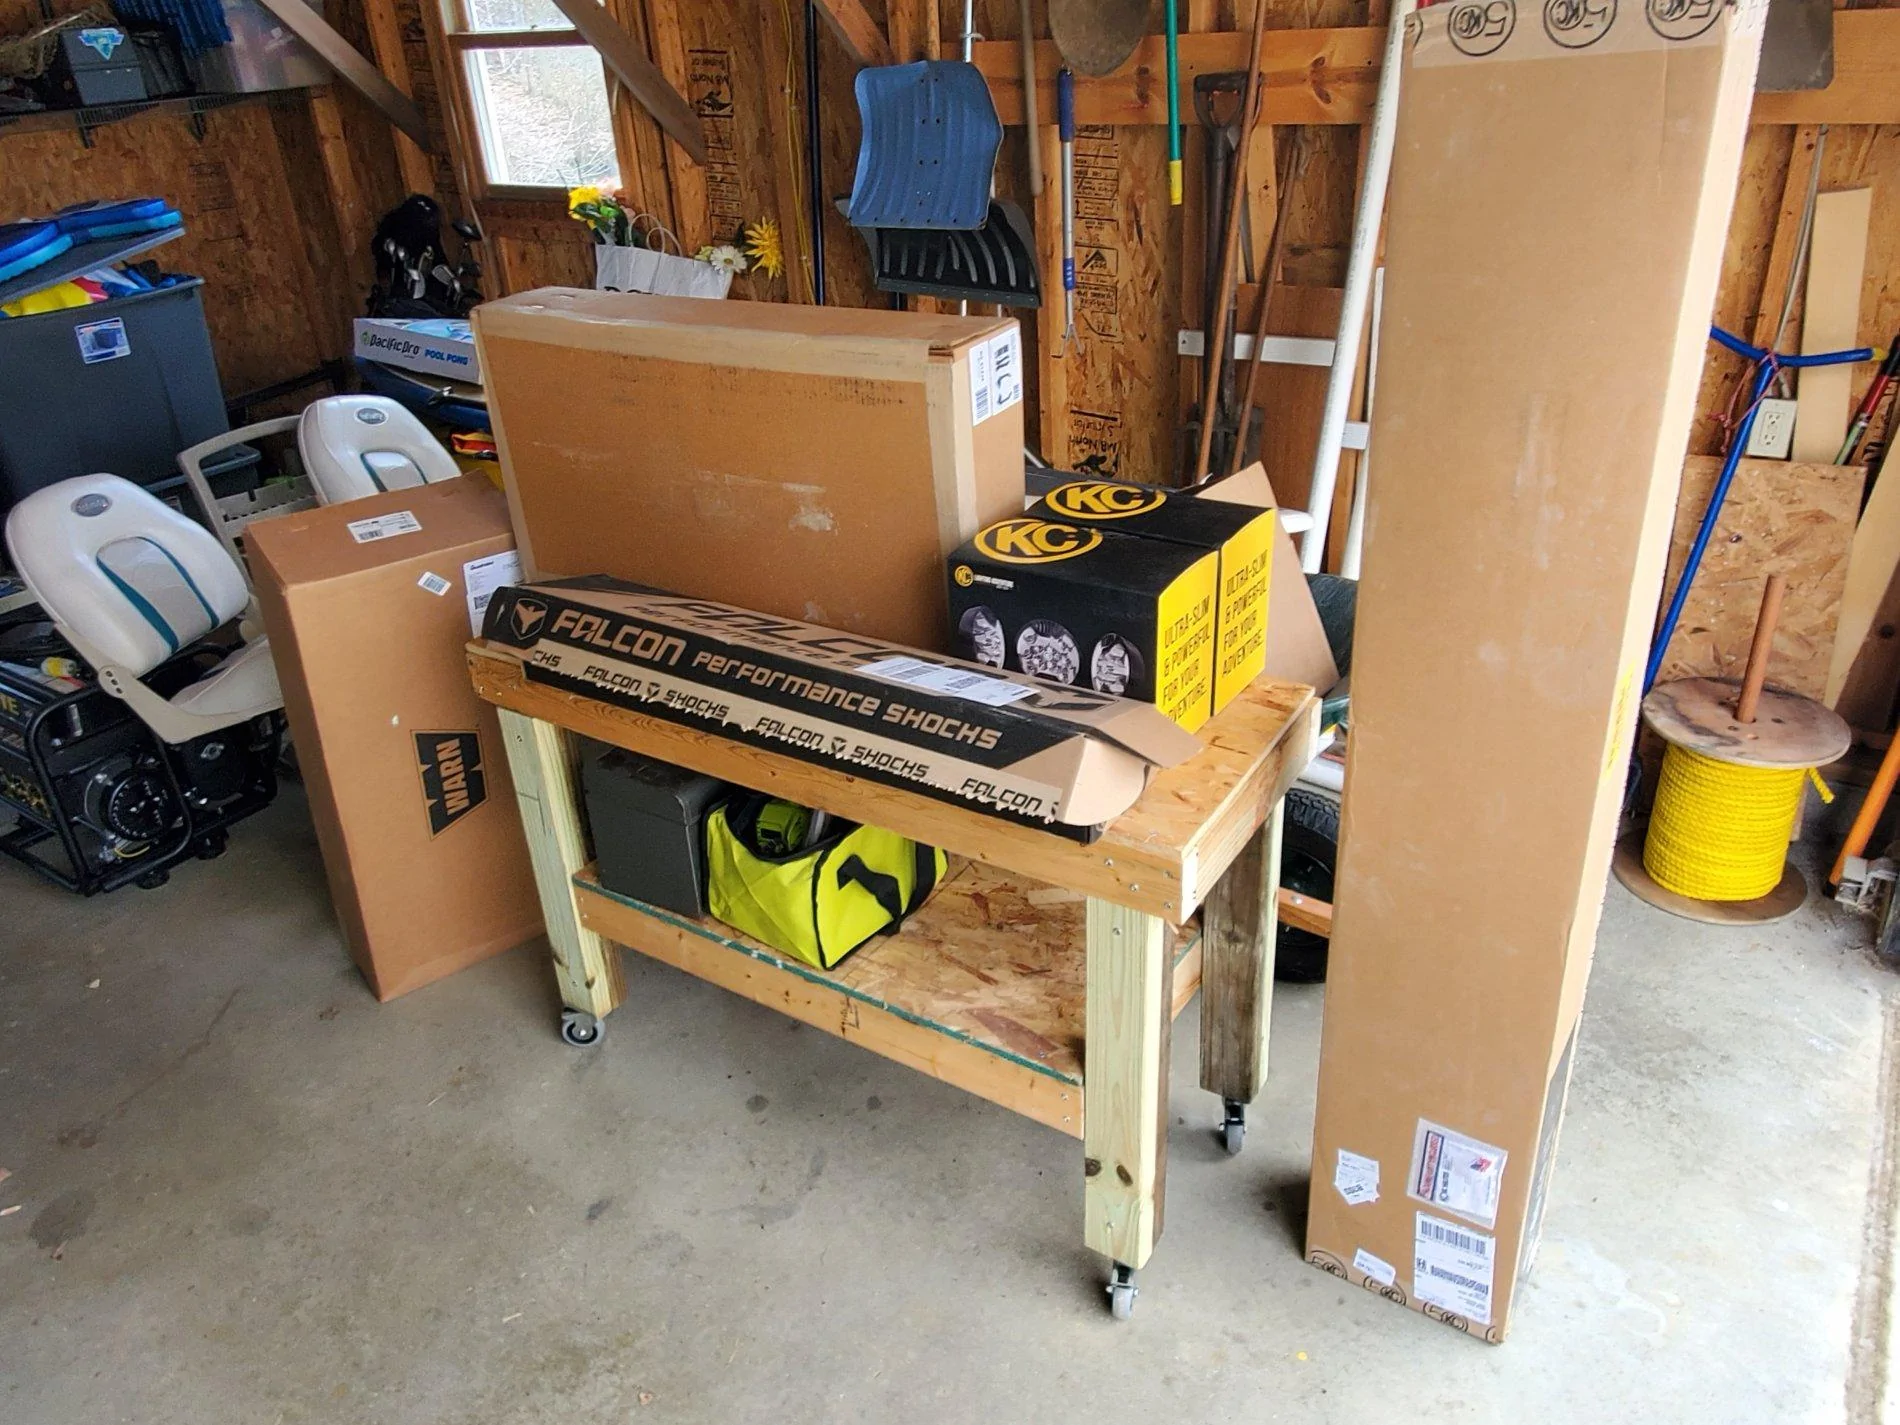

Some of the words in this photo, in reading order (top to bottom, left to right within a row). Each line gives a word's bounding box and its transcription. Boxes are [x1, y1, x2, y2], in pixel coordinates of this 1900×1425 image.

[1066, 484, 1145, 513] KC
[996, 522, 1080, 556] KC
[1226, 549, 1268, 597] ULTRA-SLIM
[1232, 575, 1267, 620] POWERFUL
[1164, 594, 1210, 649] ULTRA-SLIM
[1223, 625, 1239, 653] FOR
[1240, 609, 1257, 638] YOUR
[1171, 622, 1211, 672] POWERFUL
[1222, 627, 1264, 678] ADVENTURE
[551, 608, 687, 666] FALCON
[882, 704, 1003, 750] SHOCKS
[1162, 677, 1179, 706] FOR
[1180, 657, 1199, 690] YOUR
[583, 665, 642, 692] FALCON
[663, 689, 730, 718] SHOCKS
[755, 716, 825, 746] FALCON
[850, 745, 930, 779] SHOCKS
[960, 777, 1043, 812] FALCON
[435, 738, 470, 816] WARN
